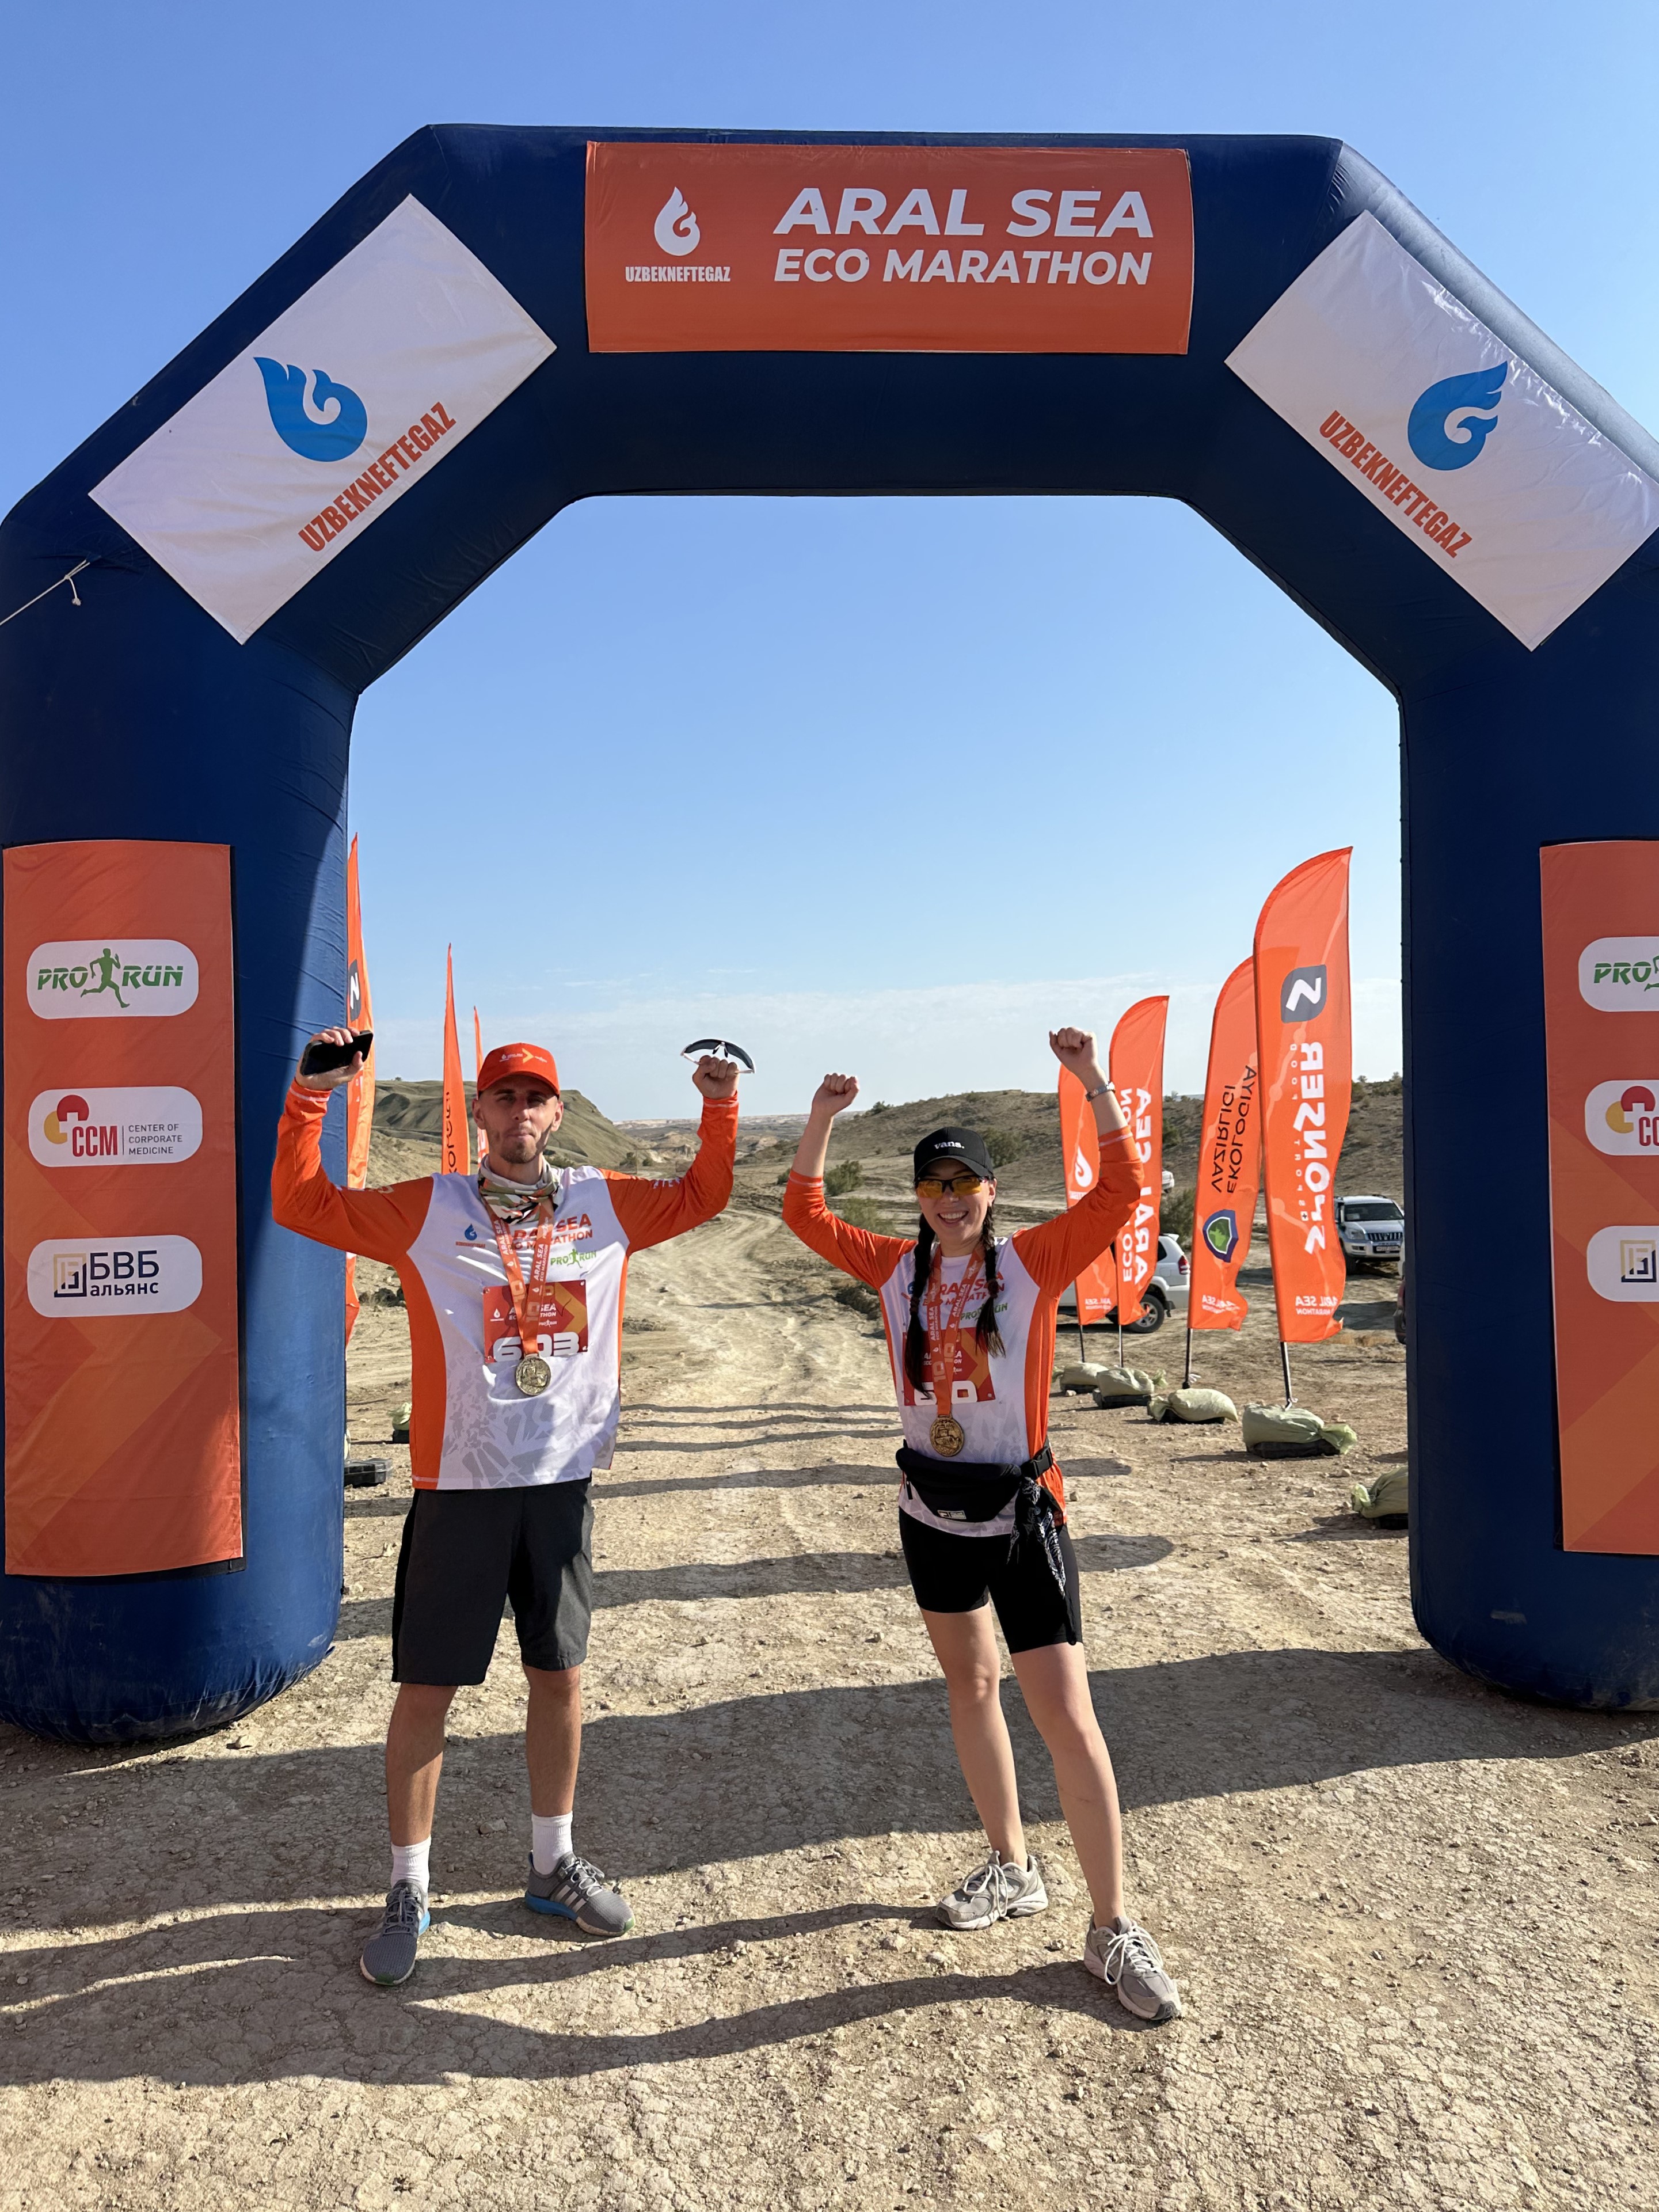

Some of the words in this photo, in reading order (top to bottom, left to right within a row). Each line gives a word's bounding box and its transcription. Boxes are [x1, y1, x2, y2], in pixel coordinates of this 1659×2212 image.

[773, 187, 985, 236] ARAL
[1006, 189, 1154, 238] SEA
[625, 266, 730, 282] UZBEKNEFTEGAZ
[774, 248, 870, 282] ECO
[882, 249, 1152, 285] MARATHON
[298, 401, 456, 552] UZBEKNEFTEGAZ
[1319, 410, 1474, 558] UZBEKNEFTEGAZ
[37, 966, 88, 991] PRO
[122, 965, 184, 989] RUN
[1594, 961, 1652, 985] PRO
[128, 1124, 165, 1132] CENTER
[168, 1123, 180, 1131] OF
[72, 1126, 118, 1157] CCM
[128, 1135, 183, 1143] CORPORATE
[934, 1141, 965, 1149] vans.
[128, 1146, 174, 1155] MEDICINE
[555, 1213, 592, 1232] SEA
[90, 1250, 159, 1280] БВБ
[550, 1256, 568, 1265] PRO
[579, 1250, 597, 1262] RUN
[533, 1259, 542, 1281] ARAL
[90, 1282, 159, 1296] альянс
[994, 1302, 1008, 1313] UN
[493, 1332, 580, 1362] 603
